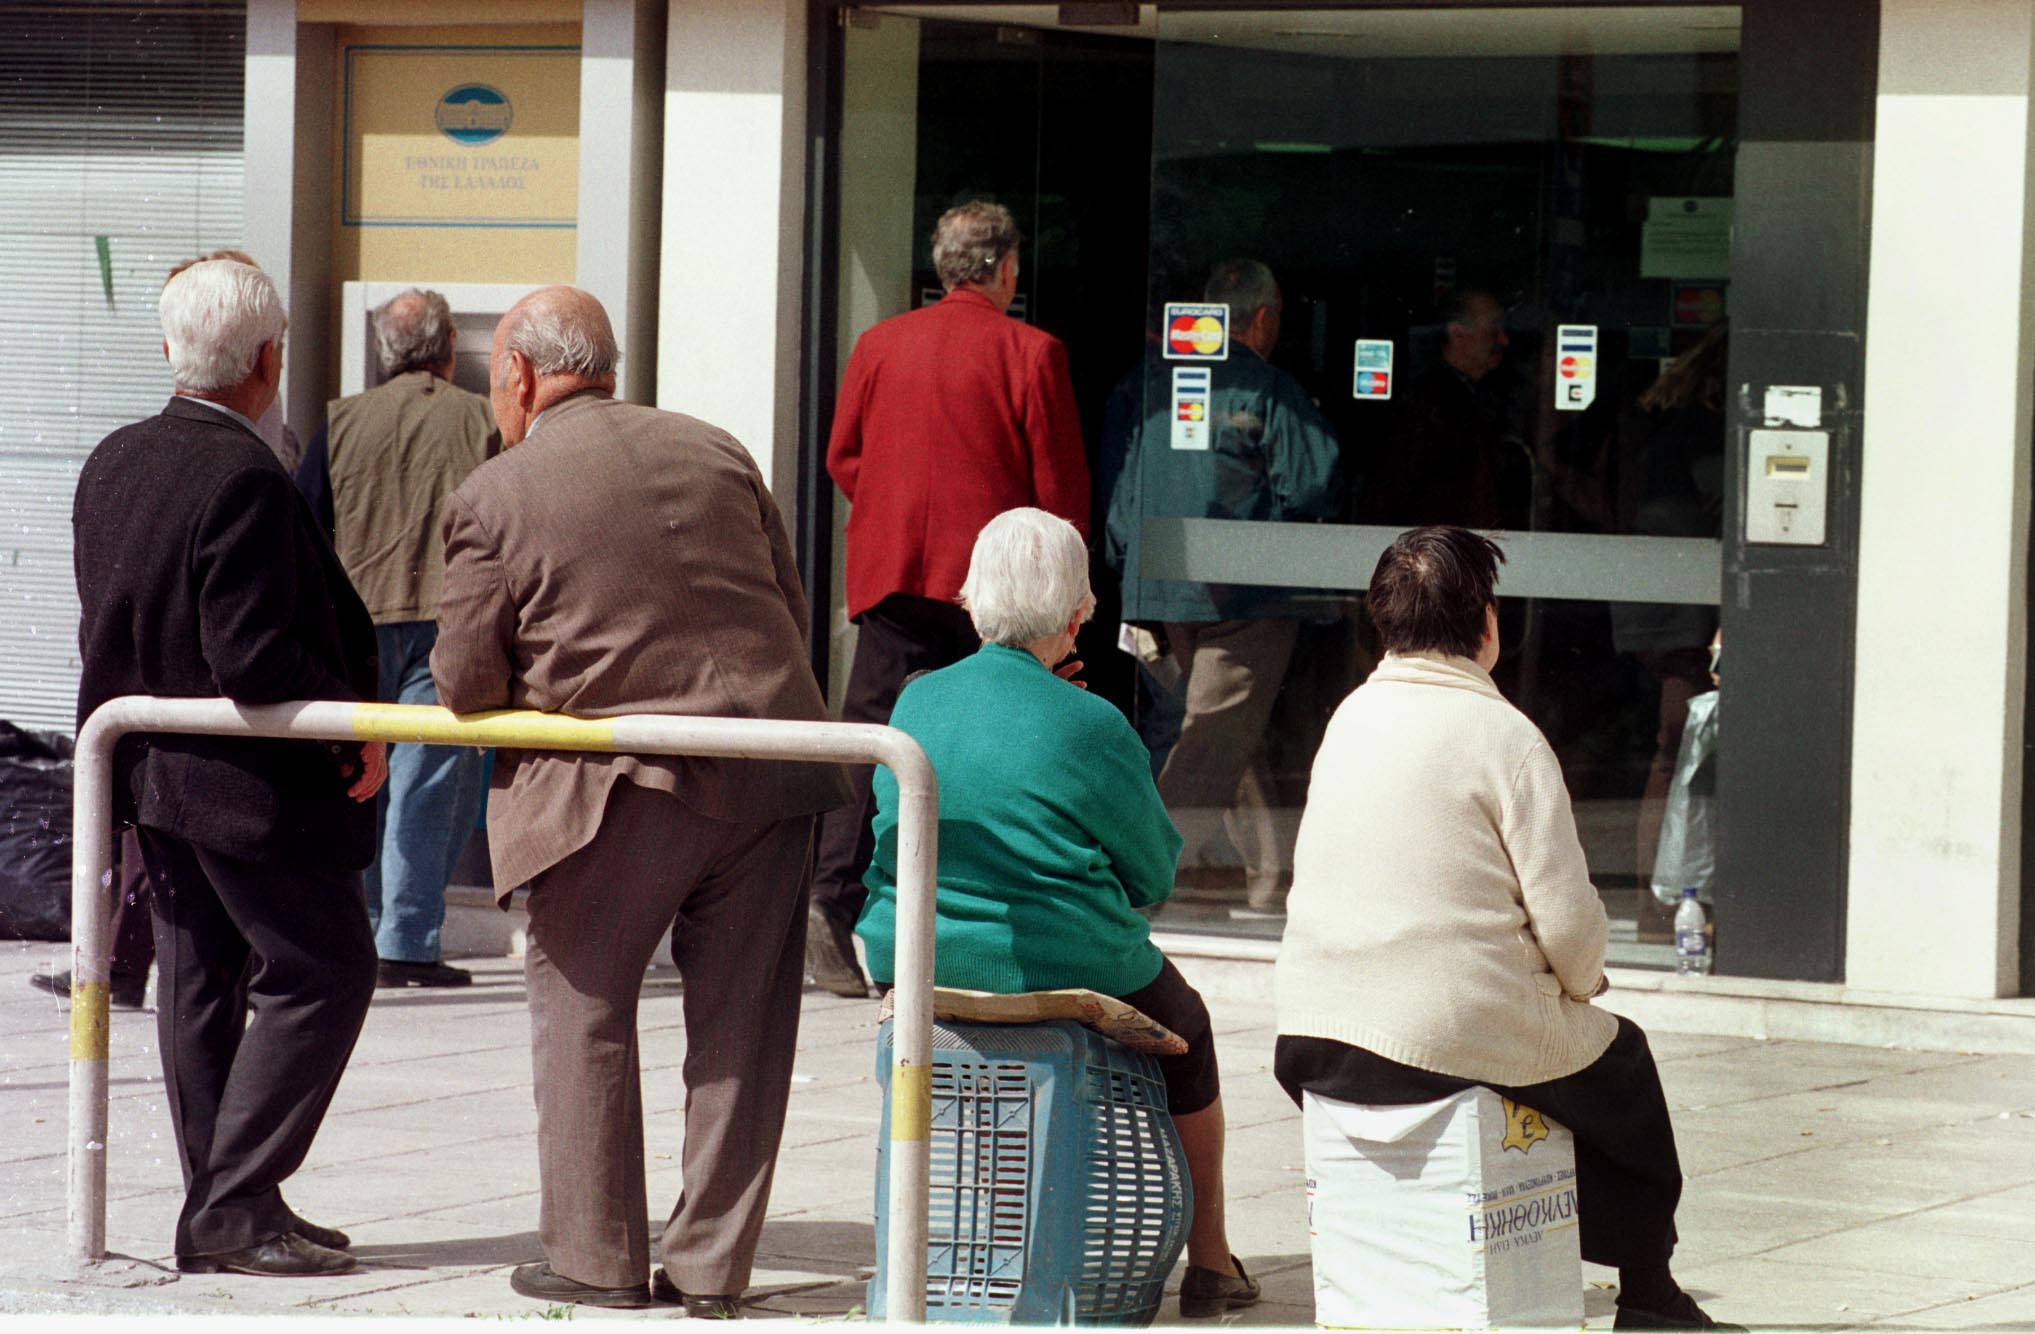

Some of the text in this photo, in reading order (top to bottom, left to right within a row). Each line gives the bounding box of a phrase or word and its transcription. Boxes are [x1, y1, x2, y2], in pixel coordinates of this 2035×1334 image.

[404, 156, 540, 171] ΕΘΝΙΚΗ ΤΡΑΠΕΖΑ
[420, 174, 528, 189] ΤΗΣ ΕΛΛΑΔΟΣ
[1170, 308, 1223, 317] EUROCARD
[1514, 1230, 1543, 1247] ΛΕΥΚΑ
